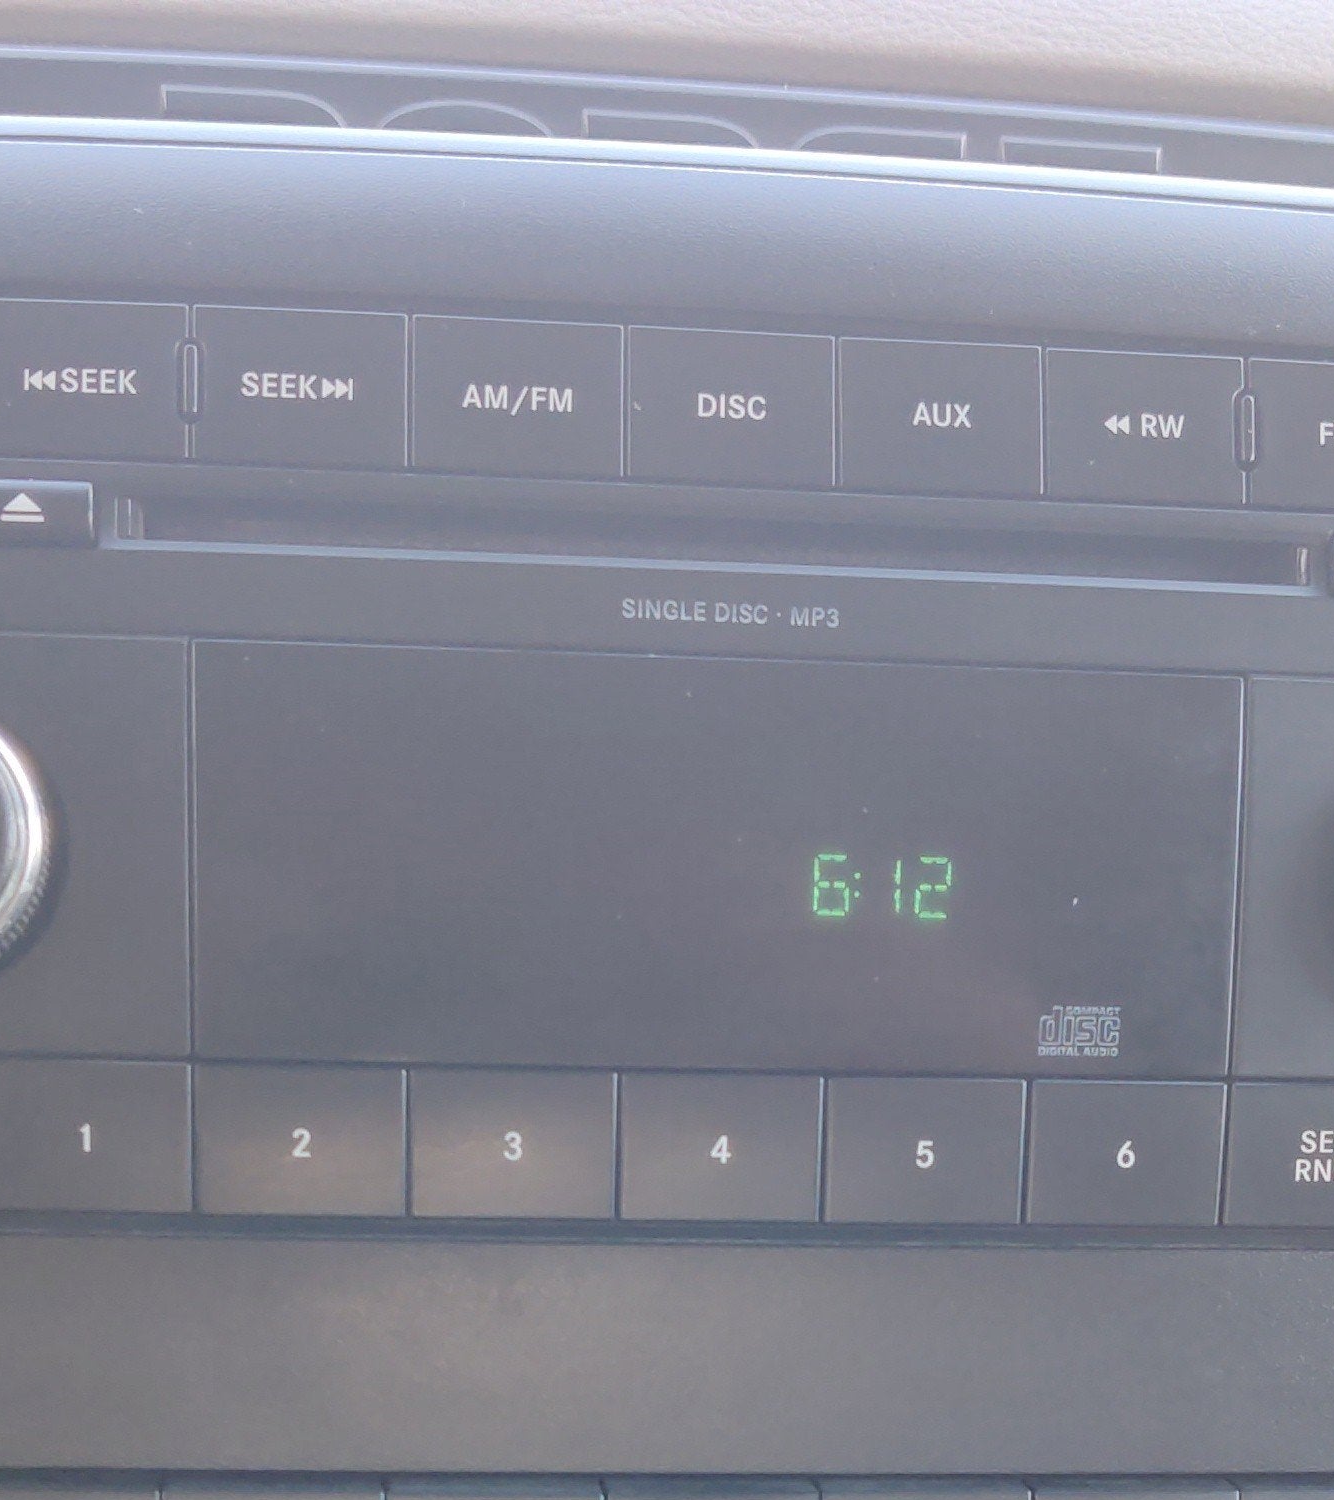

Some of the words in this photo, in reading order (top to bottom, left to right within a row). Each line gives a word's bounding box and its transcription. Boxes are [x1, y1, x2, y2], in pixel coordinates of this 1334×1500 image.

[60, 367, 137, 395] SEEK
[240, 371, 318, 400] SEEK
[461, 383, 573, 417] AM/FM
[697, 392, 767, 421] DISC
[912, 401, 972, 429] AUX
[1140, 412, 1185, 439] RW
[622, 597, 707, 622] SINGLE
[714, 601, 768, 625] DISC
[790, 606, 840, 629] MP3
[811, 852, 954, 922] 6:12
[79, 1123, 92, 1153] 1
[291, 1128, 312, 1158] 2
[503, 1131, 523, 1161] 3
[709, 1135, 732, 1165] 4
[915, 1140, 935, 1169] 5
[1116, 1140, 1136, 1169] 6
